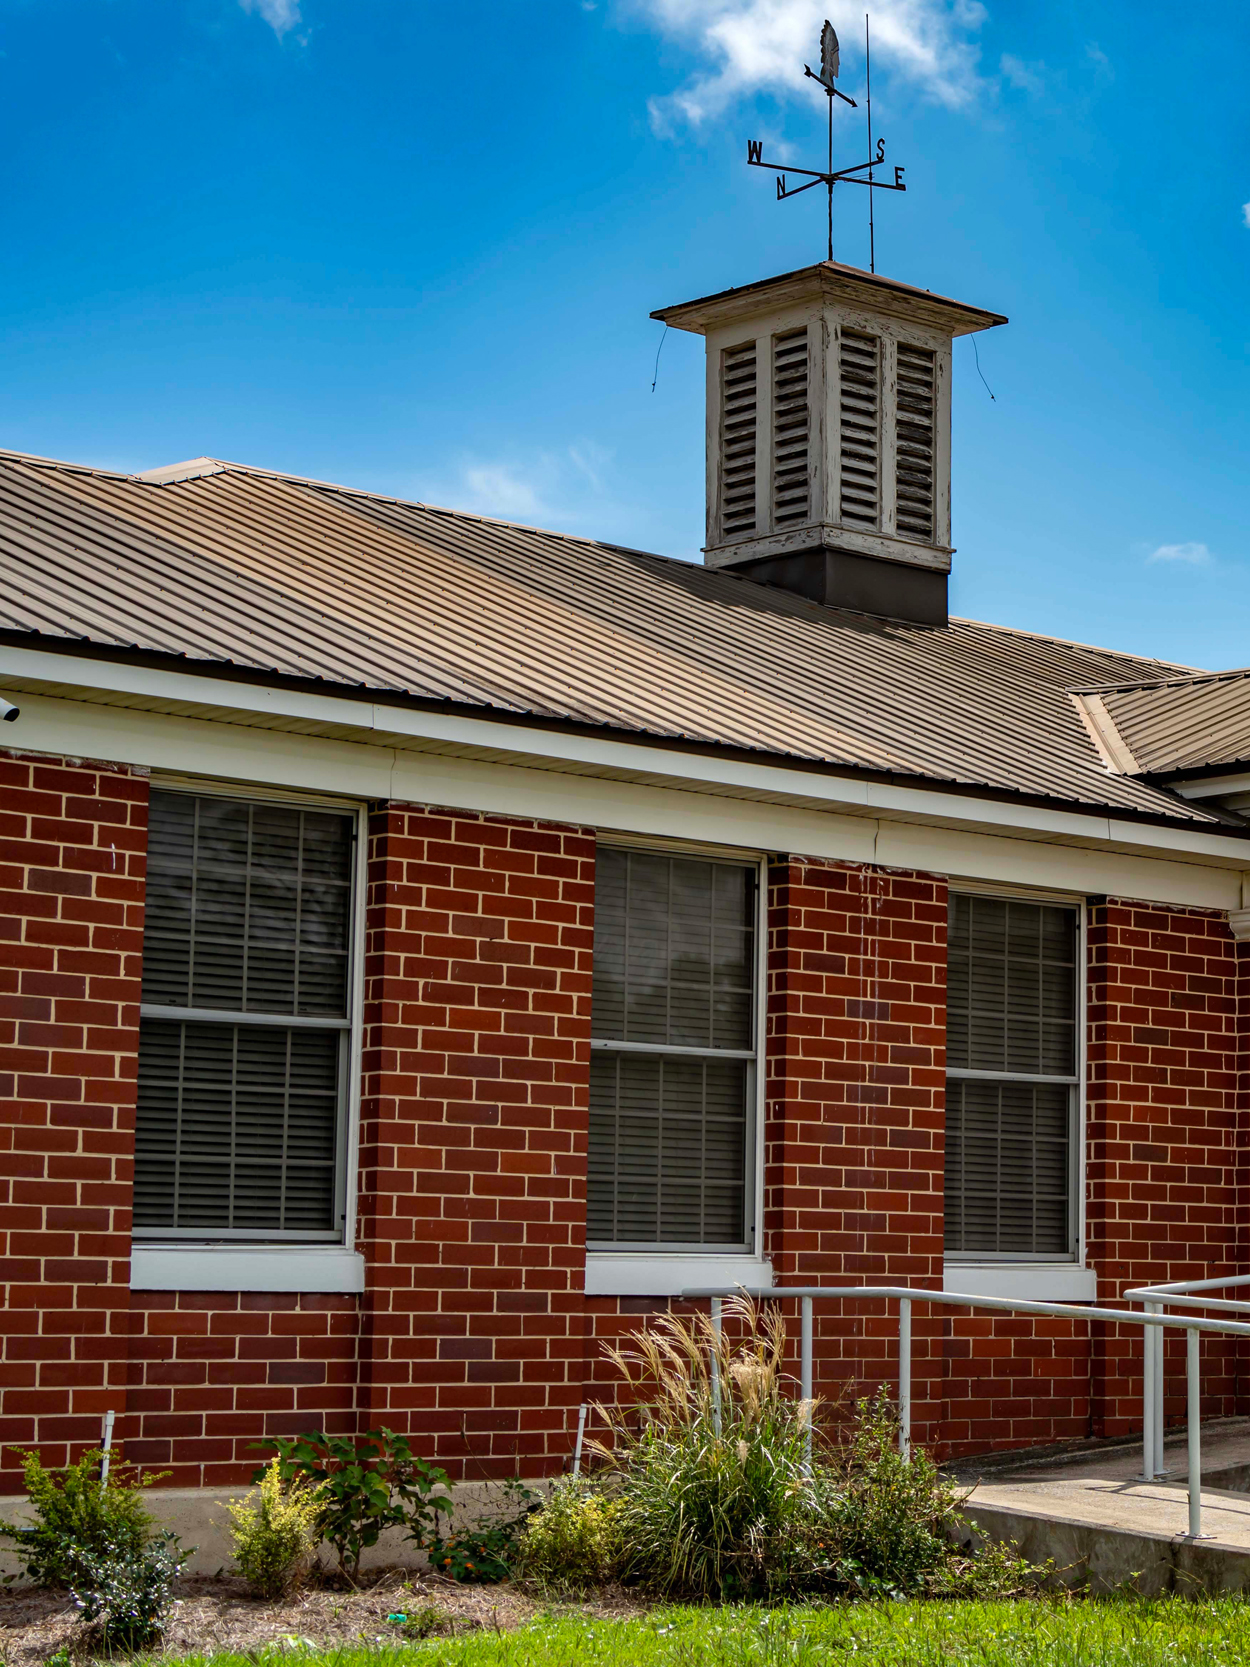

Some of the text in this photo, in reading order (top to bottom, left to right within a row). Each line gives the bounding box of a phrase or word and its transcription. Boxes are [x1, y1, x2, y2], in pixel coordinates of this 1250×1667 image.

[747, 139, 763, 163] W
[876, 138, 886, 160] S
[776, 174, 786, 200] N
[894, 166, 906, 187] E
